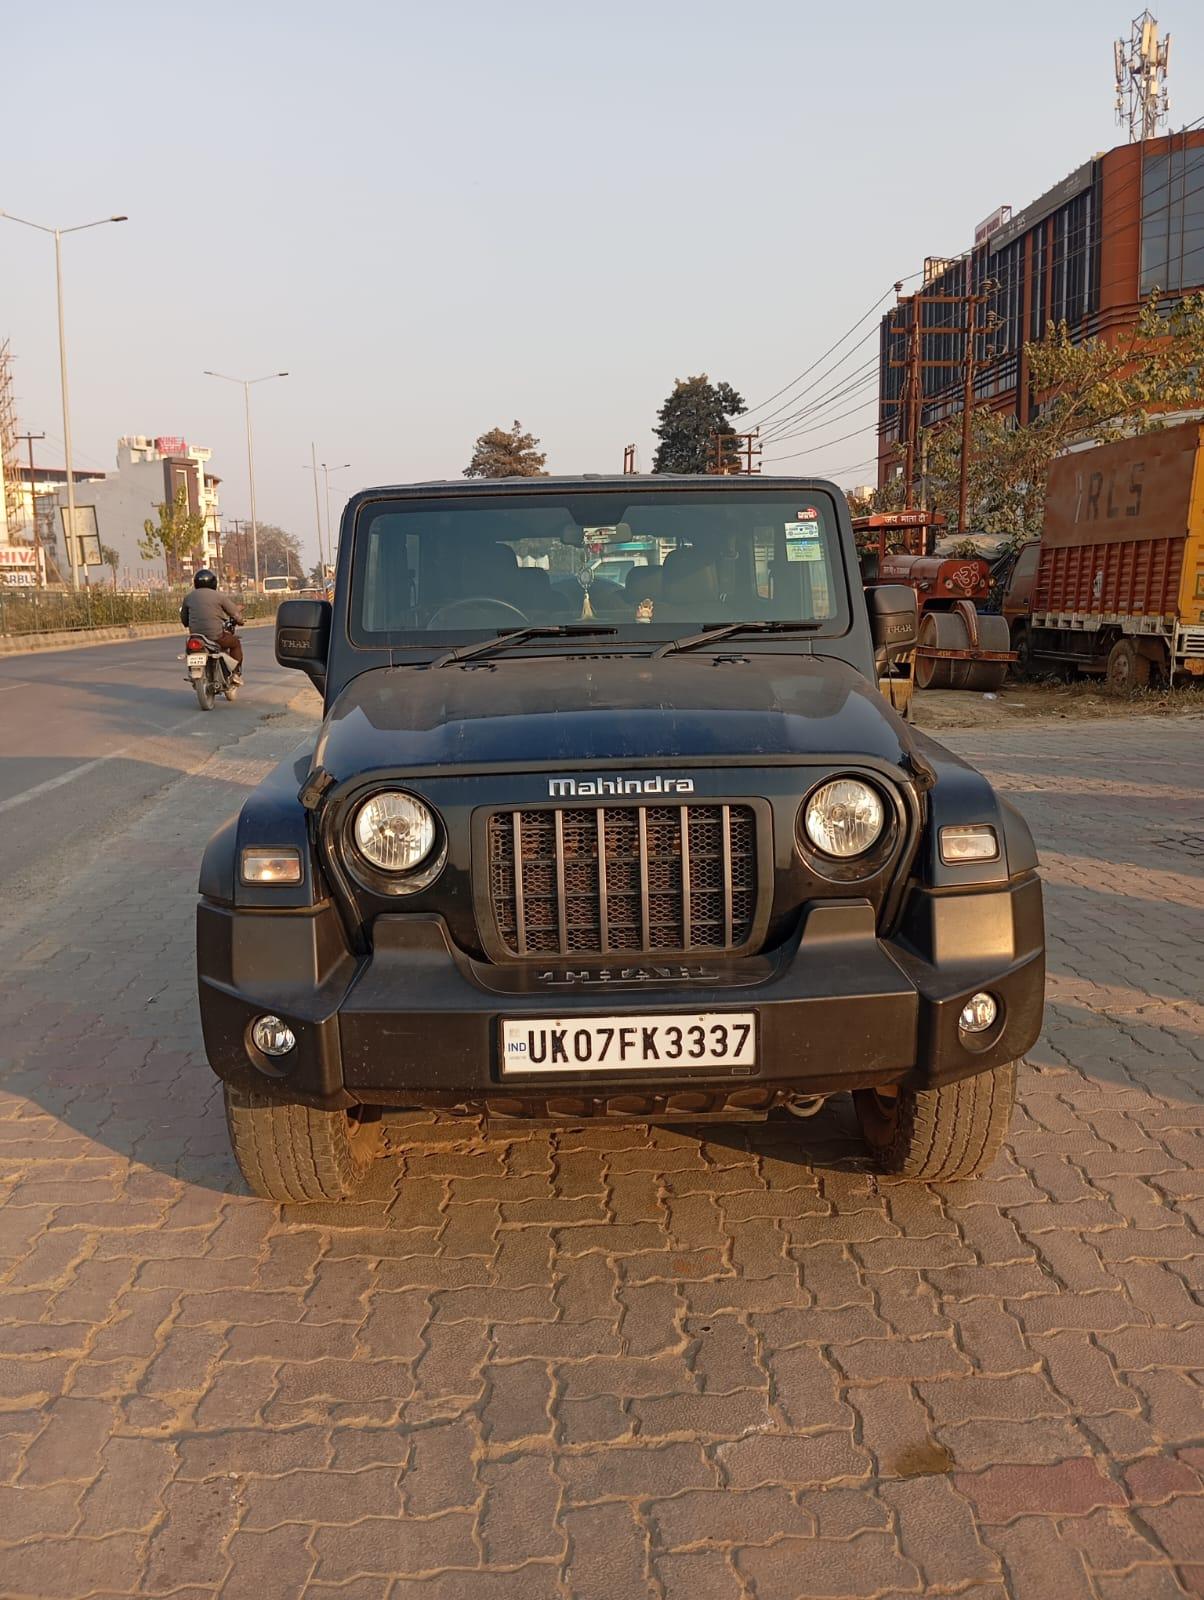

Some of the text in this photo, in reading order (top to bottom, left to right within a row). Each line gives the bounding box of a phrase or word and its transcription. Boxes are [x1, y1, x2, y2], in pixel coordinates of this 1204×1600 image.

[548, 775, 695, 797] Mahindra
[508, 1023, 751, 1064] IND UK07FK3337
